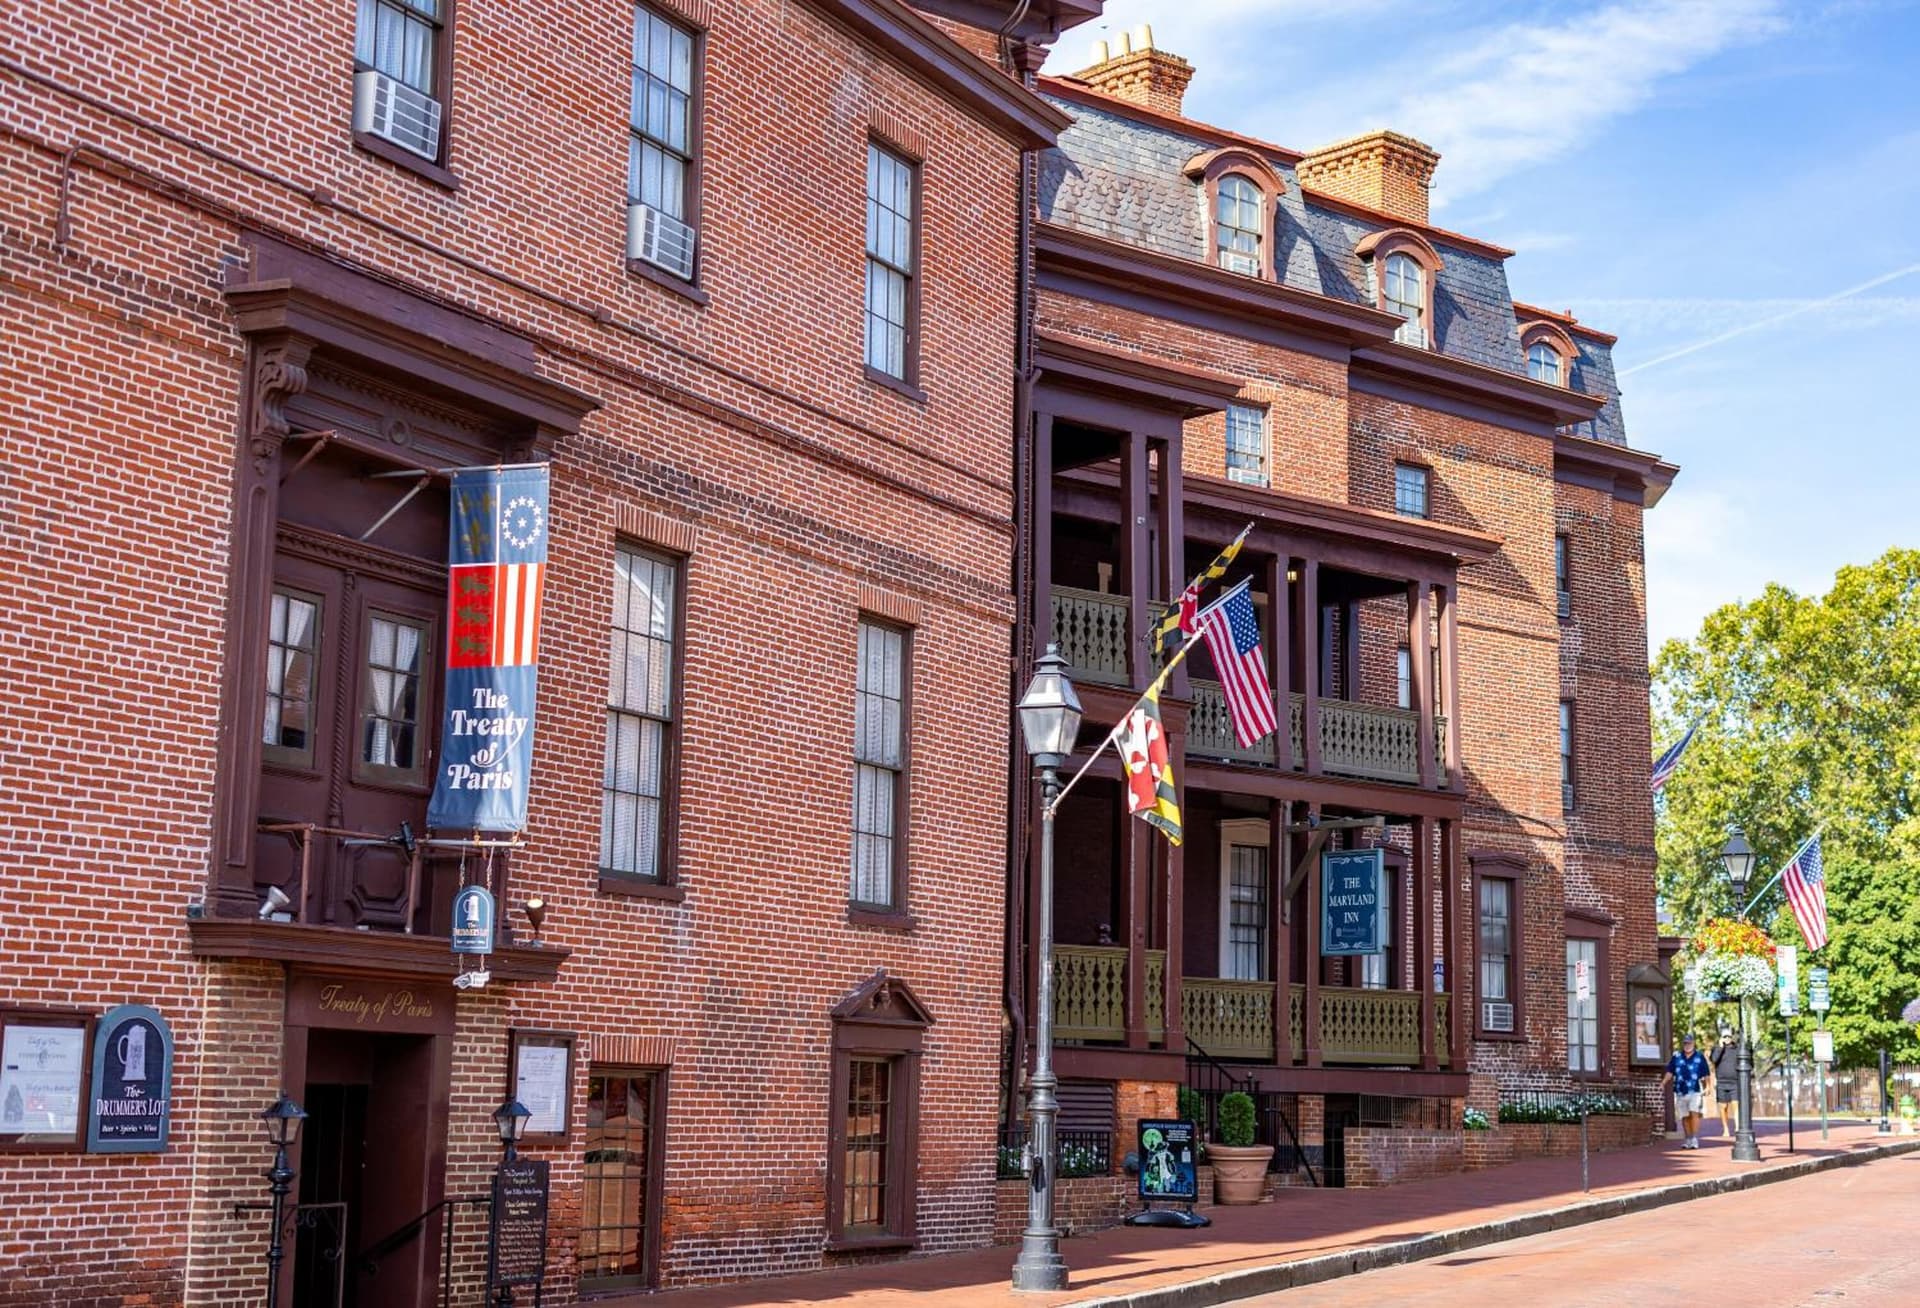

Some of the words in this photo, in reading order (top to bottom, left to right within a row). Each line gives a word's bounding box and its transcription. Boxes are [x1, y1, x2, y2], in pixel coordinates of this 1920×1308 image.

[473, 688, 509, 709] The
[477, 742, 498, 765] of
[447, 763, 513, 790] Paris
[1343, 877, 1361, 889] THE
[1328, 894, 1375, 907] MARYLAND
[1344, 911, 1359, 924] INN
[319, 985, 370, 1023] Treaty
[373, 992, 393, 1023] of
[392, 990, 433, 1017] Paris
[124, 1084, 145, 1098] The
[96, 1098, 147, 1116] DRUMMER'S
[148, 1098, 166, 1116] LOT
